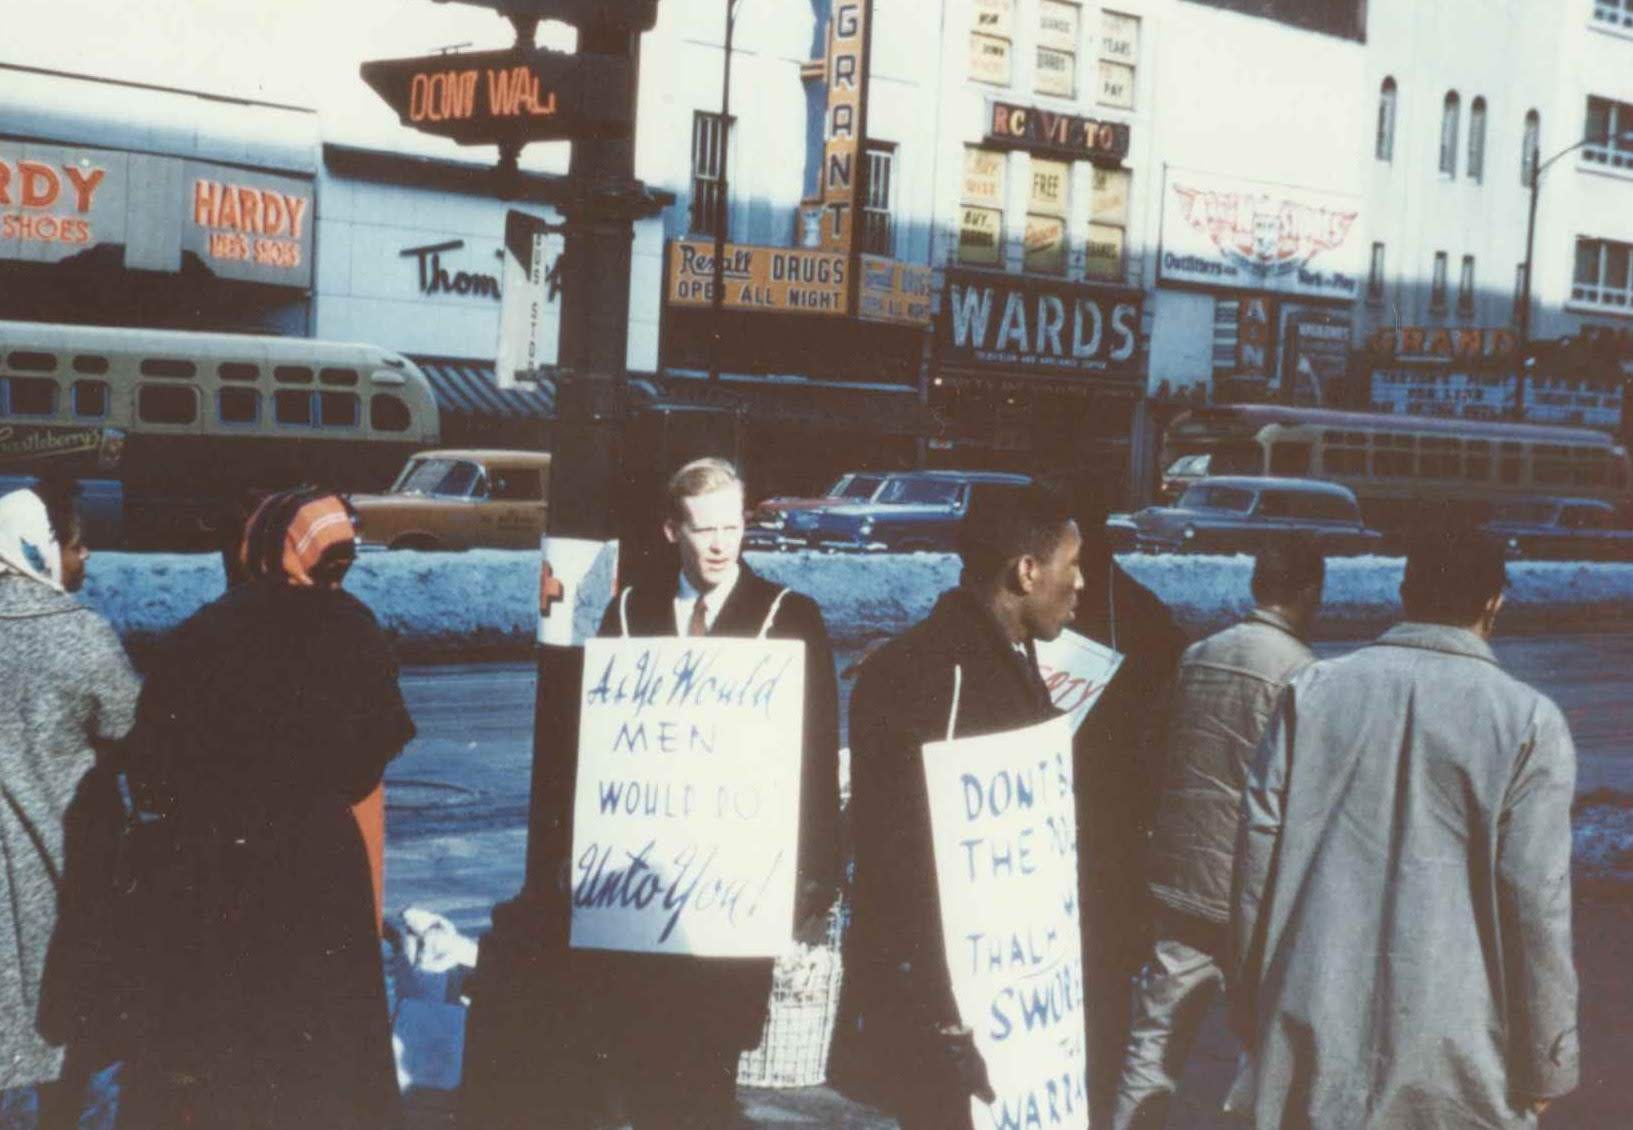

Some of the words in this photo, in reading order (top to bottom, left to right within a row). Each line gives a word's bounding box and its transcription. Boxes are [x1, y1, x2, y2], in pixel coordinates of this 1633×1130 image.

[410, 71, 479, 121] DONT
[829, 5, 858, 236] GRANT
[194, 179, 306, 238] HARDY
[1033, 173, 1059, 198] FREE
[3, 214, 89, 244] SHOES
[253, 238, 301, 269] SHOES
[398, 239, 503, 303] Thom
[773, 254, 844, 285] DRUGS
[740, 285, 775, 307] ALL
[788, 290, 842, 309] NIGHT
[951, 284, 1137, 361] WARDS
[666, 650, 793, 719] Would
[613, 721, 716, 754] MEN
[599, 780, 693, 819] WOULD
[574, 841, 664, 911] Unto
[959, 829, 1036, 884] THE
